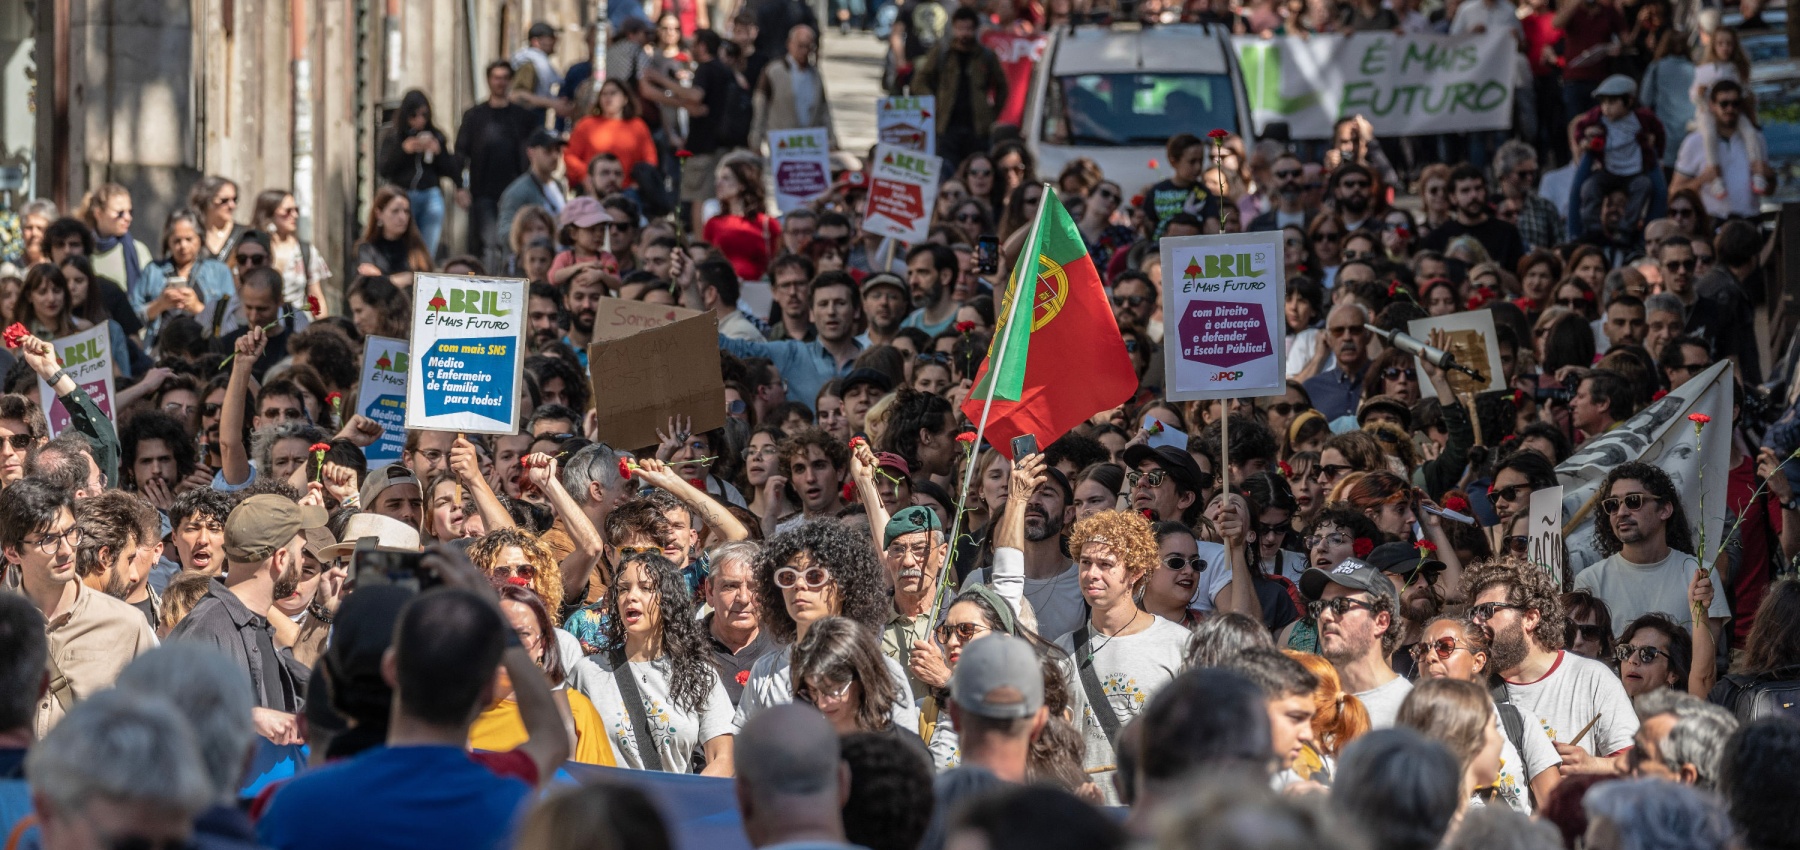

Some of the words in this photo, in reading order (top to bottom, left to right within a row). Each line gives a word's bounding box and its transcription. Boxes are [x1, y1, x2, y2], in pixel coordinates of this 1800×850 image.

[1360, 38, 1386, 76] É
[1402, 40, 1478, 73] MAIS
[1338, 79, 1508, 120] FUTURO
[1255, 252, 1266, 261] 50
[1182, 253, 1269, 279] ABRIL
[1182, 281, 1193, 293] É
[1196, 282, 1220, 293] MAIS
[1223, 280, 1266, 293] FUTURO
[426, 286, 513, 317] ABRIL
[501, 291, 512, 300] 50
[1192, 308, 1212, 318] com
[1214, 305, 1249, 316] Direito
[425, 313, 435, 325] É
[438, 315, 463, 327] MAIS
[466, 316, 509, 330] FUTURO
[1205, 320, 1212, 330] à
[1214, 318, 1260, 331] educação
[1193, 335, 1199, 343] e
[1201, 331, 1247, 342] defender
[438, 343, 459, 353] com
[461, 344, 485, 355] mais
[488, 345, 507, 356] SNS
[1184, 347, 1191, 356] a
[1193, 344, 1224, 356] Escola
[1226, 342, 1267, 354] Pública!
[428, 356, 465, 369] Médico
[371, 371, 380, 381] É
[427, 370, 435, 379] e
[436, 369, 492, 382] Enfermeiro
[1218, 371, 1244, 382] PCP
[426, 379, 440, 391] de
[442, 380, 479, 393] família
[380, 399, 399, 408] com
[444, 394, 469, 405] para
[471, 394, 503, 406] todos!
[370, 408, 402, 422] Médico
[380, 443, 403, 453] para
